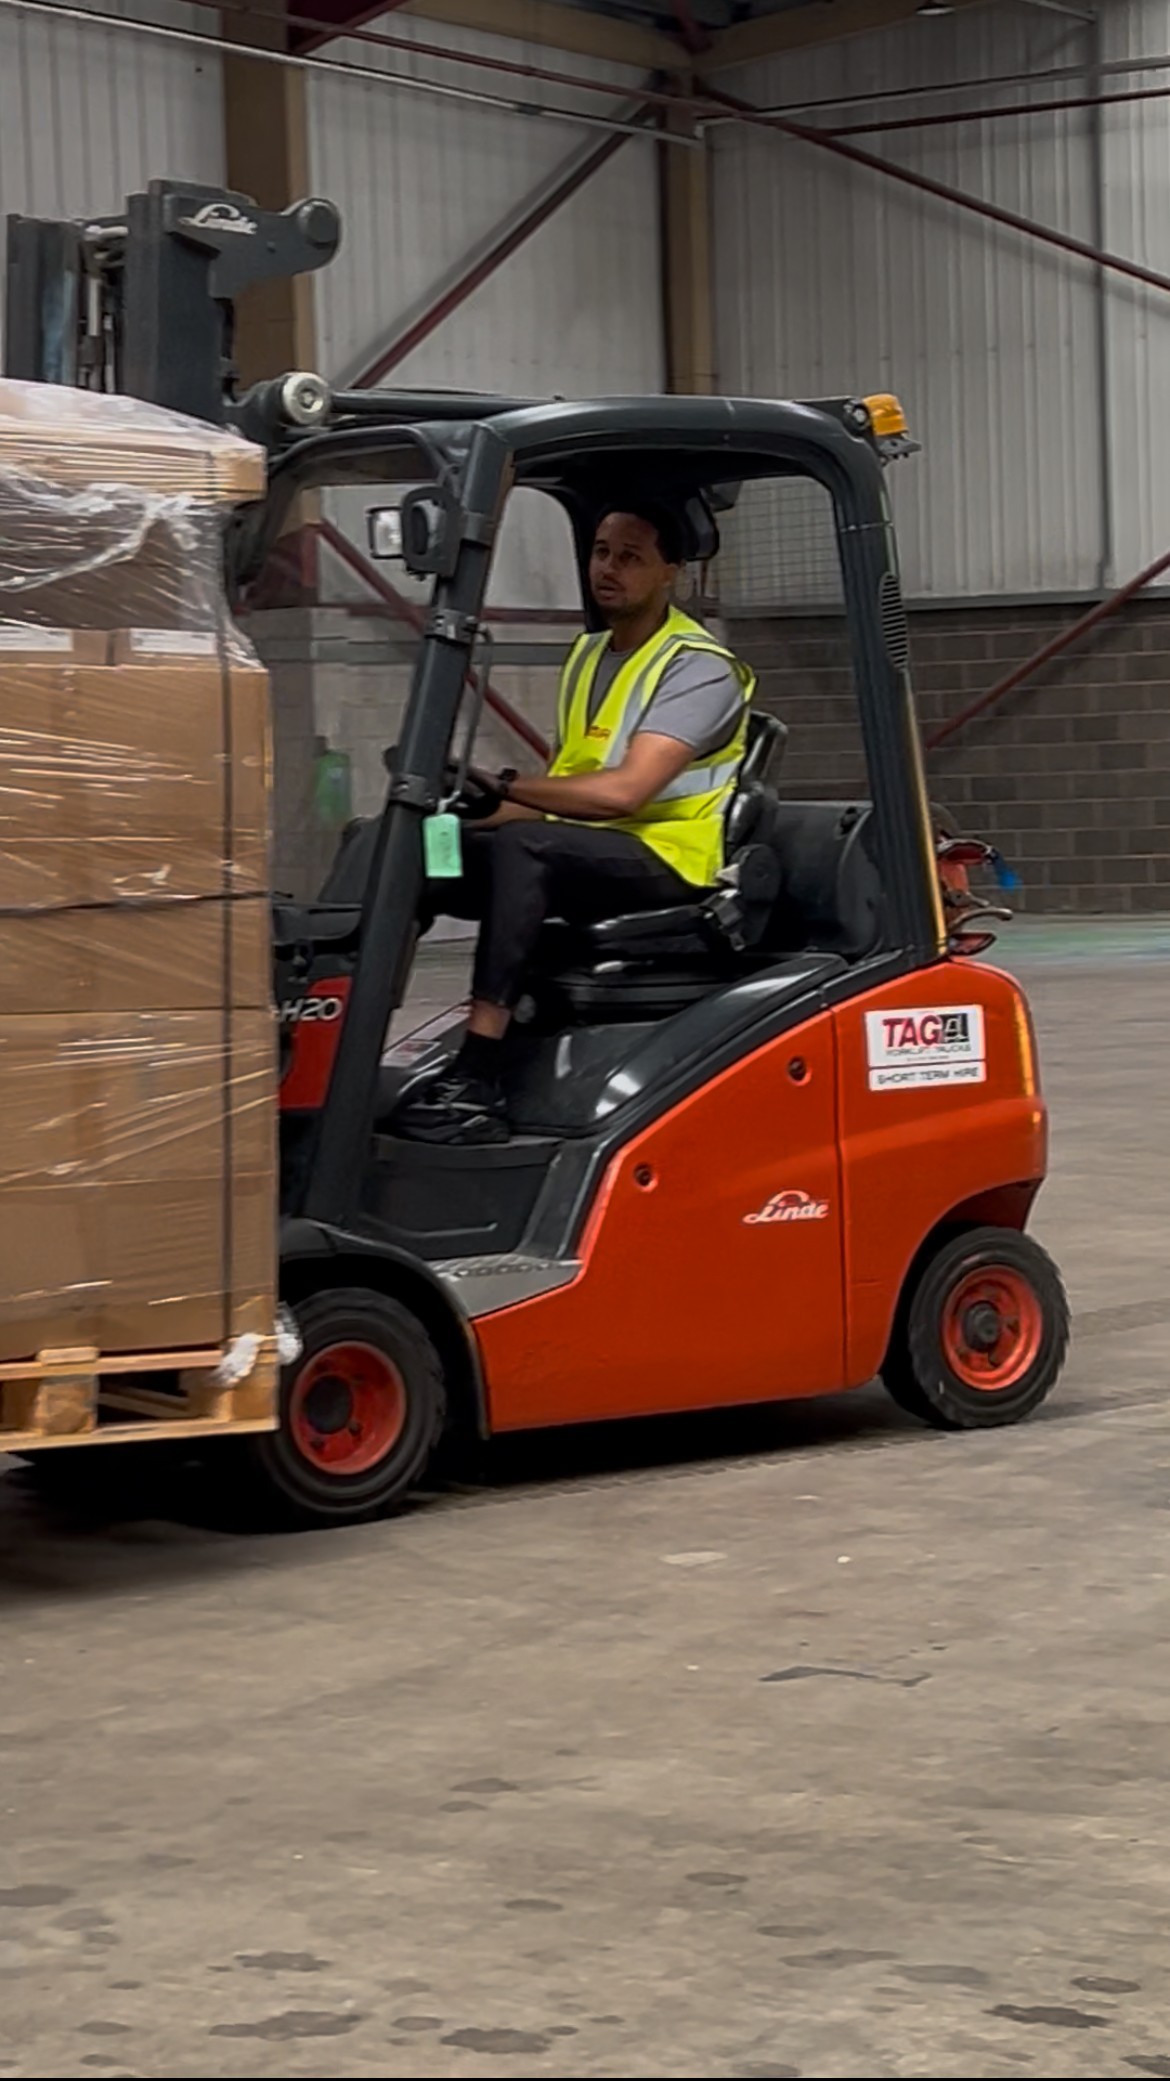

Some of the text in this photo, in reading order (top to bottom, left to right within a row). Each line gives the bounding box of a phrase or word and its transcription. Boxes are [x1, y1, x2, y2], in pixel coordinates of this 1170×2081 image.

[280, 998, 342, 1021] H20
[882, 1015, 943, 1048] TAG
[877, 1066, 979, 1085] SHORT TERM HIRE
[742, 1189, 829, 1224] Linde
